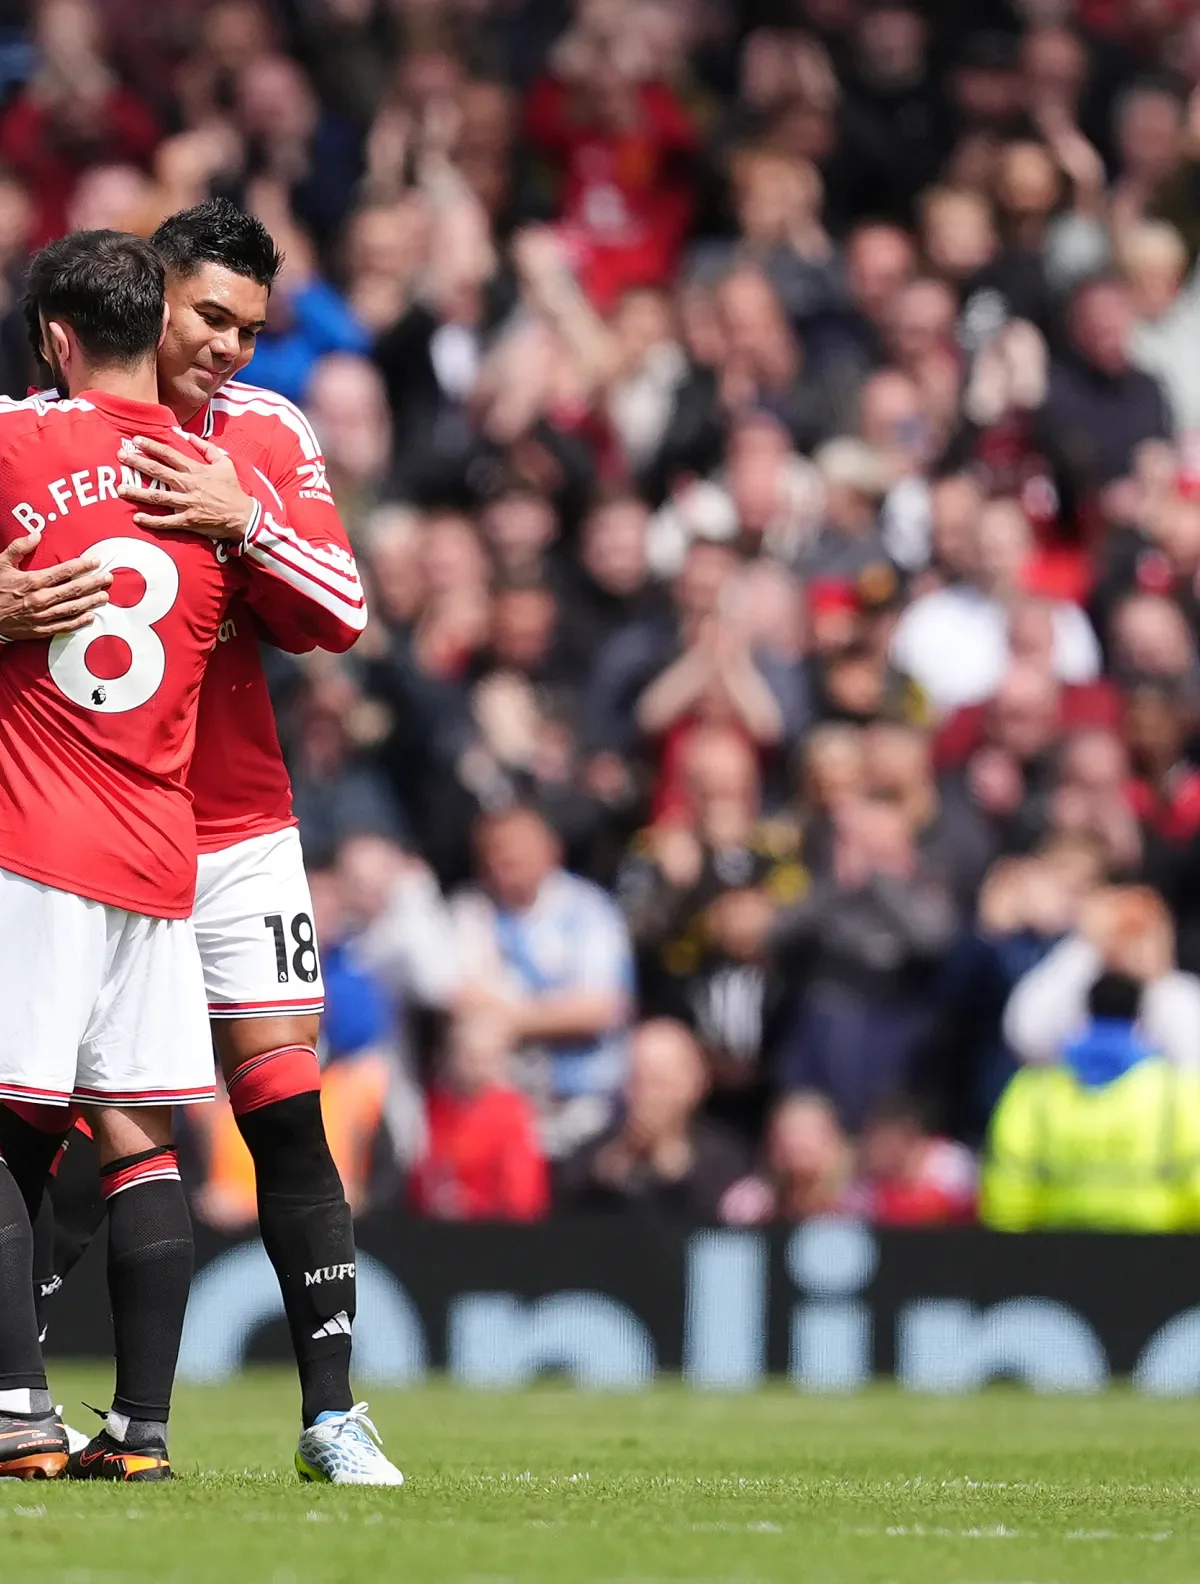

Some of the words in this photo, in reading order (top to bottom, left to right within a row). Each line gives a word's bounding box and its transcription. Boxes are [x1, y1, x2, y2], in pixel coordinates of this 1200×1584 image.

[47, 536, 180, 714] 8
[263, 912, 319, 983] 18
[303, 1262, 356, 1287] MUFC
